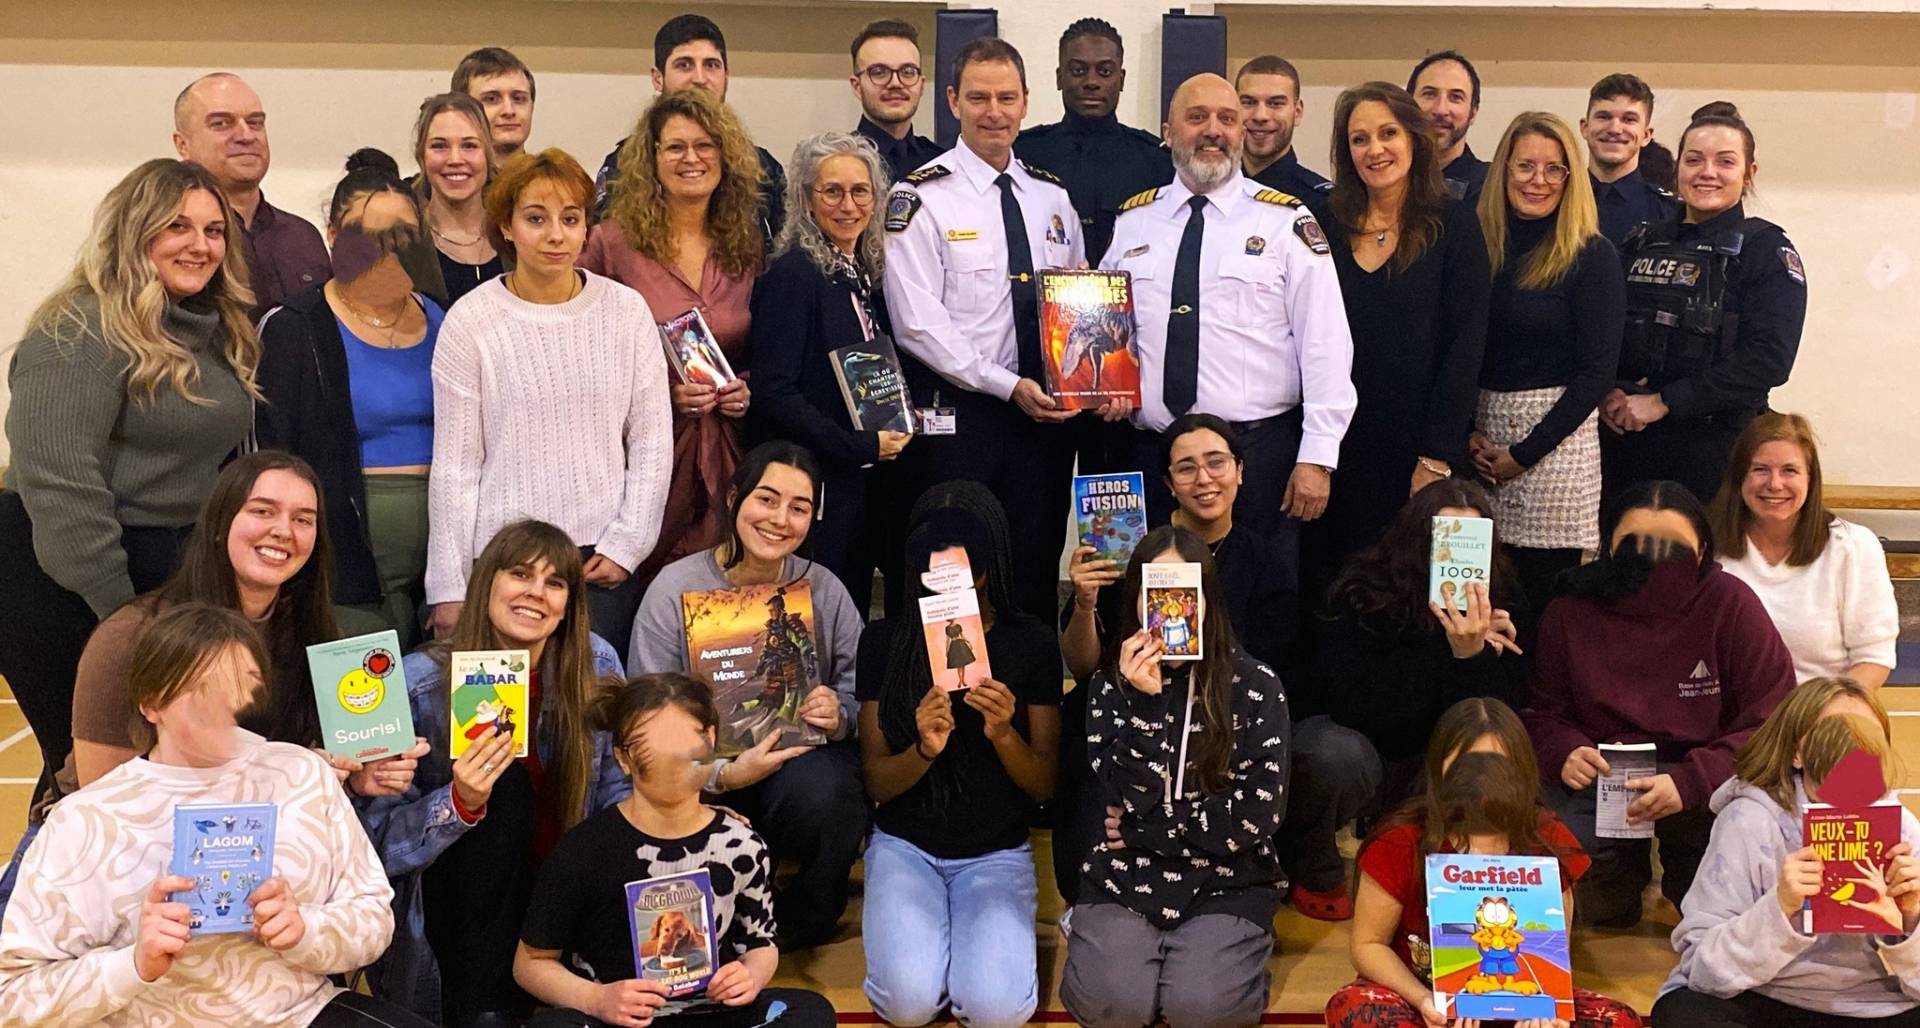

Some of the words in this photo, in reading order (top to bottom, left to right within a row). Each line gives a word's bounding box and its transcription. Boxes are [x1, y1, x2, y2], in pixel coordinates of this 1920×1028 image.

[893, 192, 917, 201] POLICE
[1630, 258, 1677, 276] POLICE
[1081, 494, 1138, 512] FUSION
[1440, 566, 1484, 580] 1002
[465, 674, 517, 685] BABAR
[1810, 821, 1870, 841] VEUX-TU
[203, 835, 254, 848] LAGOM
[1838, 842, 1870, 861] LIME
[1873, 841, 1884, 860] ?
[1443, 864, 1543, 885] Garfield
